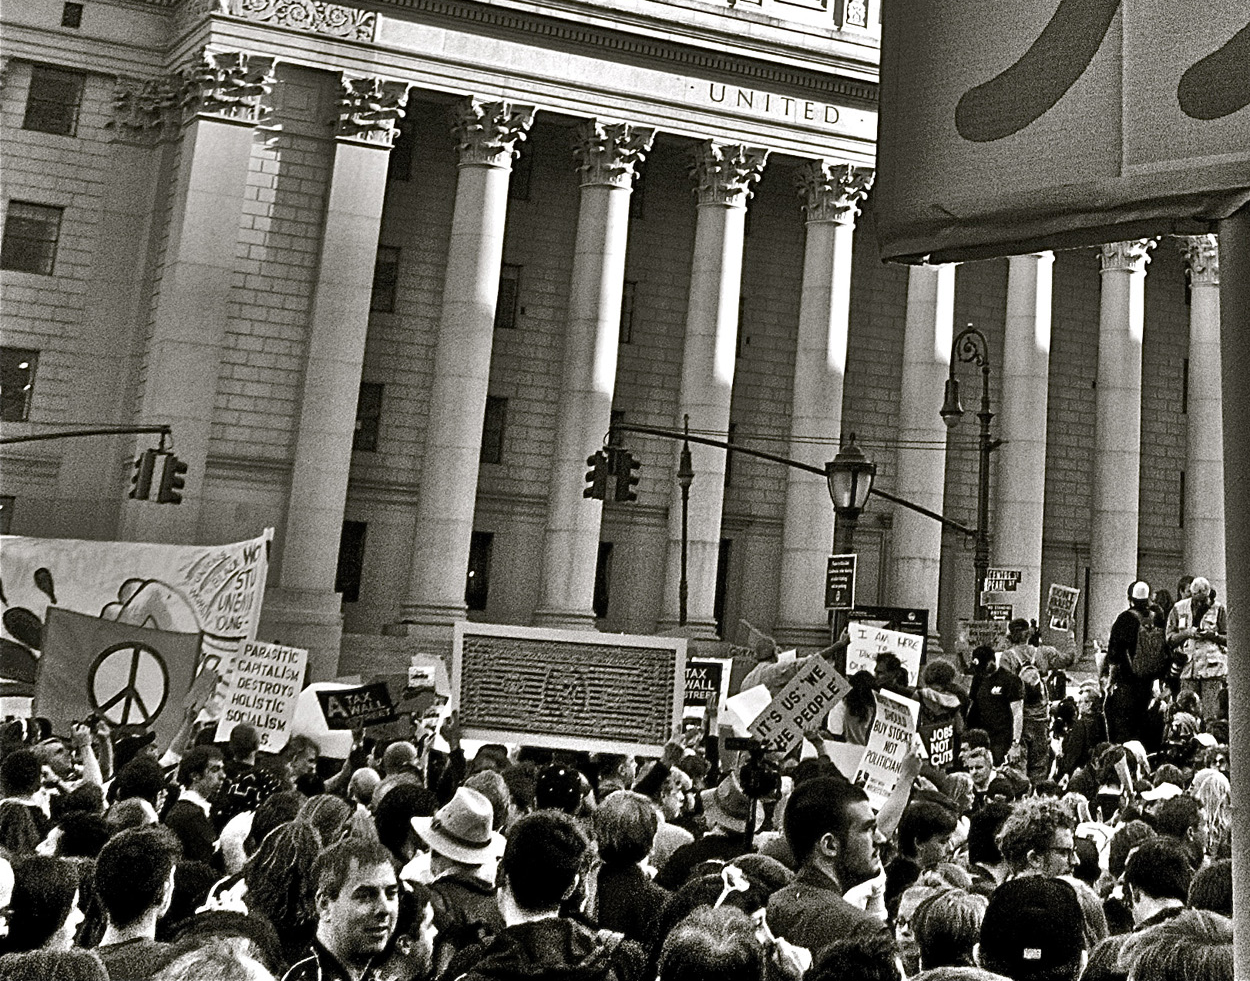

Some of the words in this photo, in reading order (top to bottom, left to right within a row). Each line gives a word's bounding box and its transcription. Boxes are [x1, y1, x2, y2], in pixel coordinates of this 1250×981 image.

[709, 83, 839, 124] UNITED
[858, 630, 867, 639] I
[244, 644, 299, 663] PARASITIC
[238, 660, 299, 681] CAPITALISM
[685, 668, 707, 679] TAX
[231, 693, 285, 713] HOLISTIC
[328, 696, 349, 717] A
[345, 692, 372, 705] TAX
[226, 709, 286, 731] SOCIALISM
[756, 710, 782, 737] IT'S
[873, 719, 887, 736] BUY
[888, 726, 912, 744] STOCKS
[930, 725, 953, 742] JOBS
[883, 741, 898, 755] NOT
[931, 739, 949, 755] NOT
[931, 749, 953, 766] CUTS
